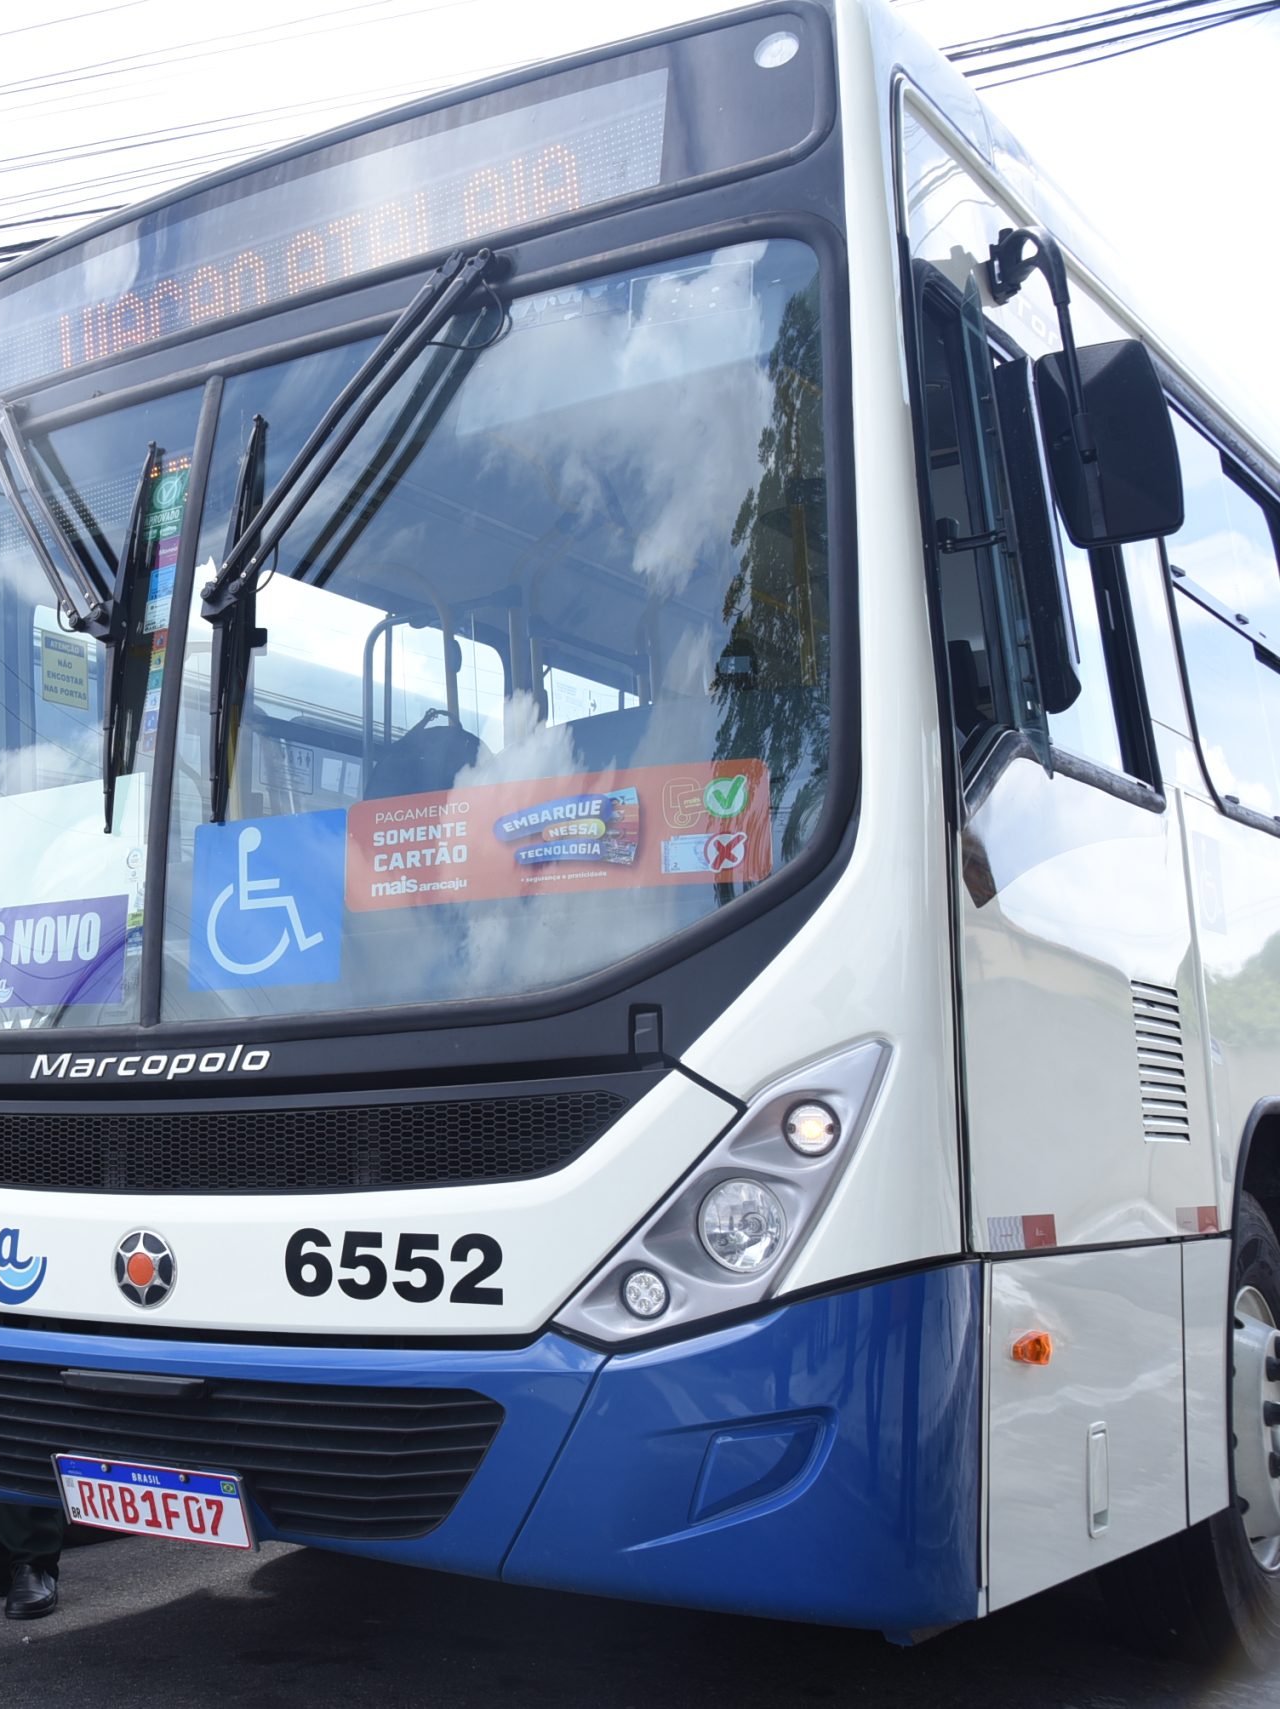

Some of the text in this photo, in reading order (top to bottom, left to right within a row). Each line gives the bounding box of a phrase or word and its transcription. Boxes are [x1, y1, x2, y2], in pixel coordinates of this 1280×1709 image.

[47, 670, 84, 686] ENCOSTAR
[60, 687, 87, 700] PORTAS
[375, 801, 470, 824] PAGAMENTO
[502, 799, 602, 833] EMBARQUE
[373, 821, 467, 847] SOMENTE
[548, 822, 598, 838] NESSA
[373, 841, 468, 873] CARTÃO
[519, 843, 601, 860] TECNOLOGIA
[371, 875, 468, 897] mais aracaju
[11, 912, 101, 965] NOVO
[29, 1044, 271, 1079] Marcopolo
[284, 1228, 504, 1306] 6552
[132, 1472, 161, 1485] BRASIL
[71, 1506, 82, 1519] BR
[77, 1480, 224, 1536] RRB1F07
